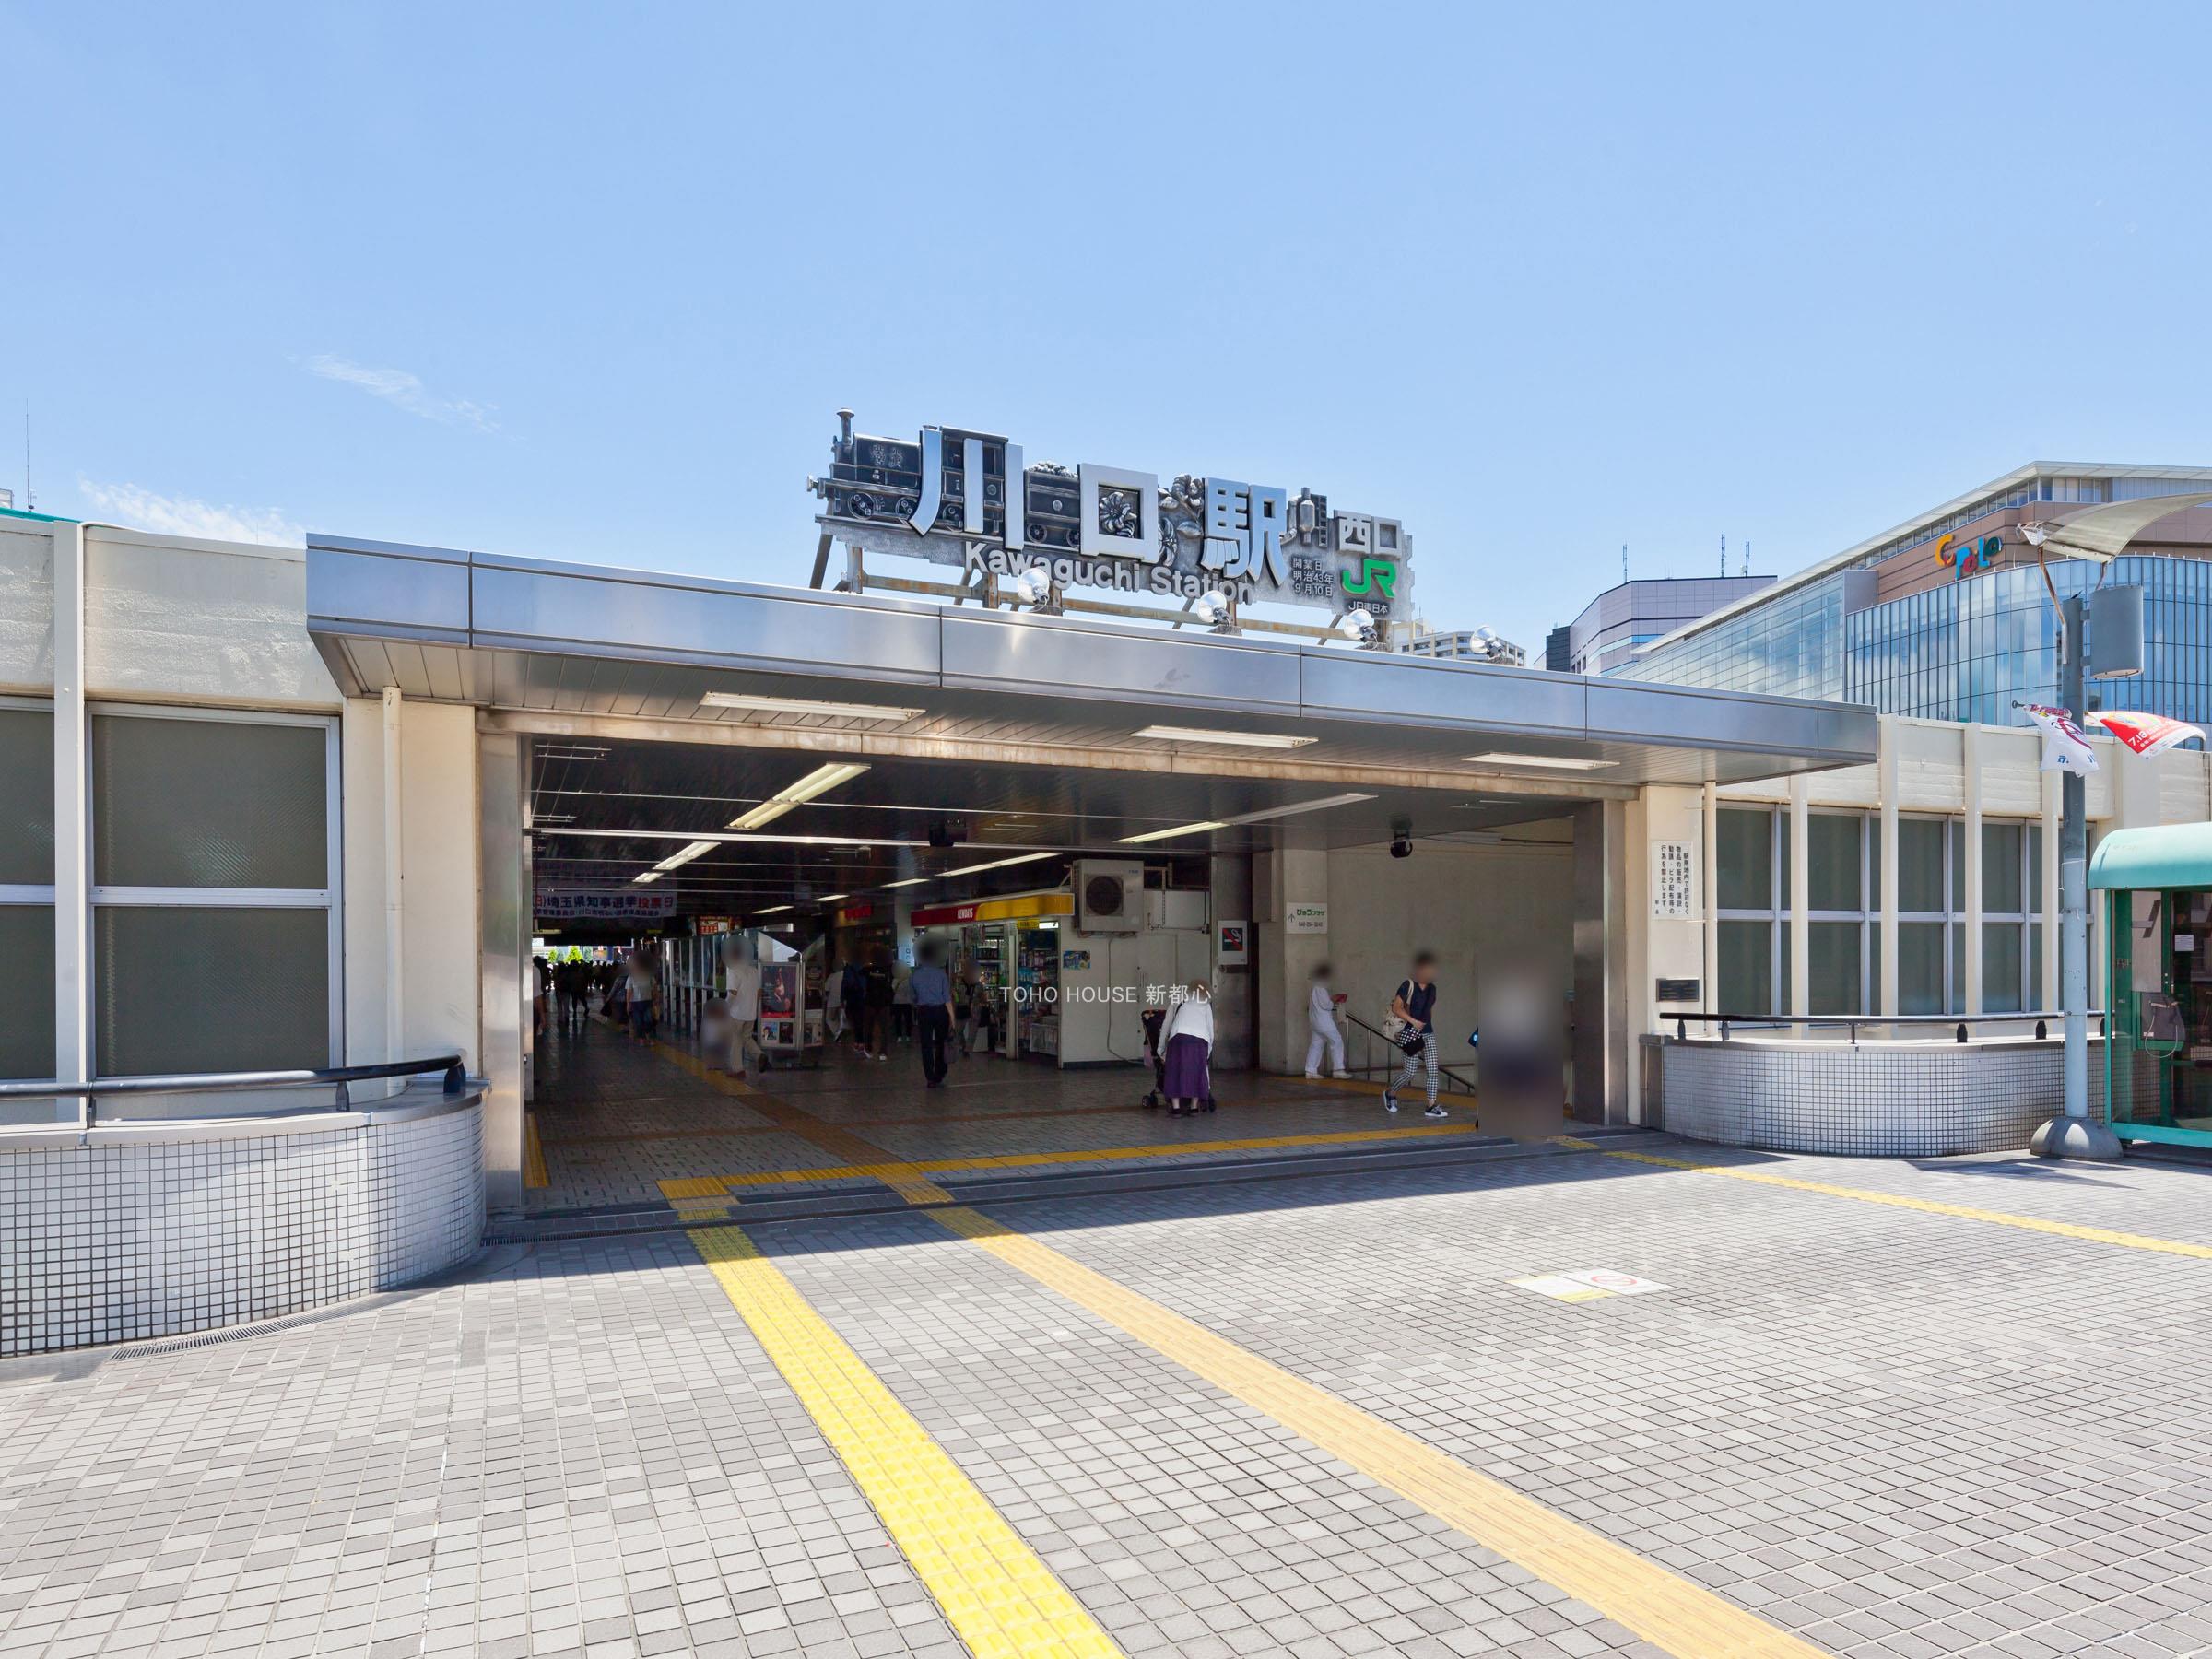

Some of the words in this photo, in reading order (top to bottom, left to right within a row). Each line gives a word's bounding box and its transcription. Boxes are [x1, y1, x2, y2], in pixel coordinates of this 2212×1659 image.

[908, 425, 1289, 587] 川口駅
[1334, 510, 1401, 559] 西口
[965, 541, 1140, 592] Kawaguchi
[1150, 566, 1253, 606] Station
[1292, 558, 1322, 571] 開業日
[1292, 571, 1334, 584] 明治43年
[1341, 559, 1396, 599] JR
[1294, 584, 1334, 597] 9月10日
